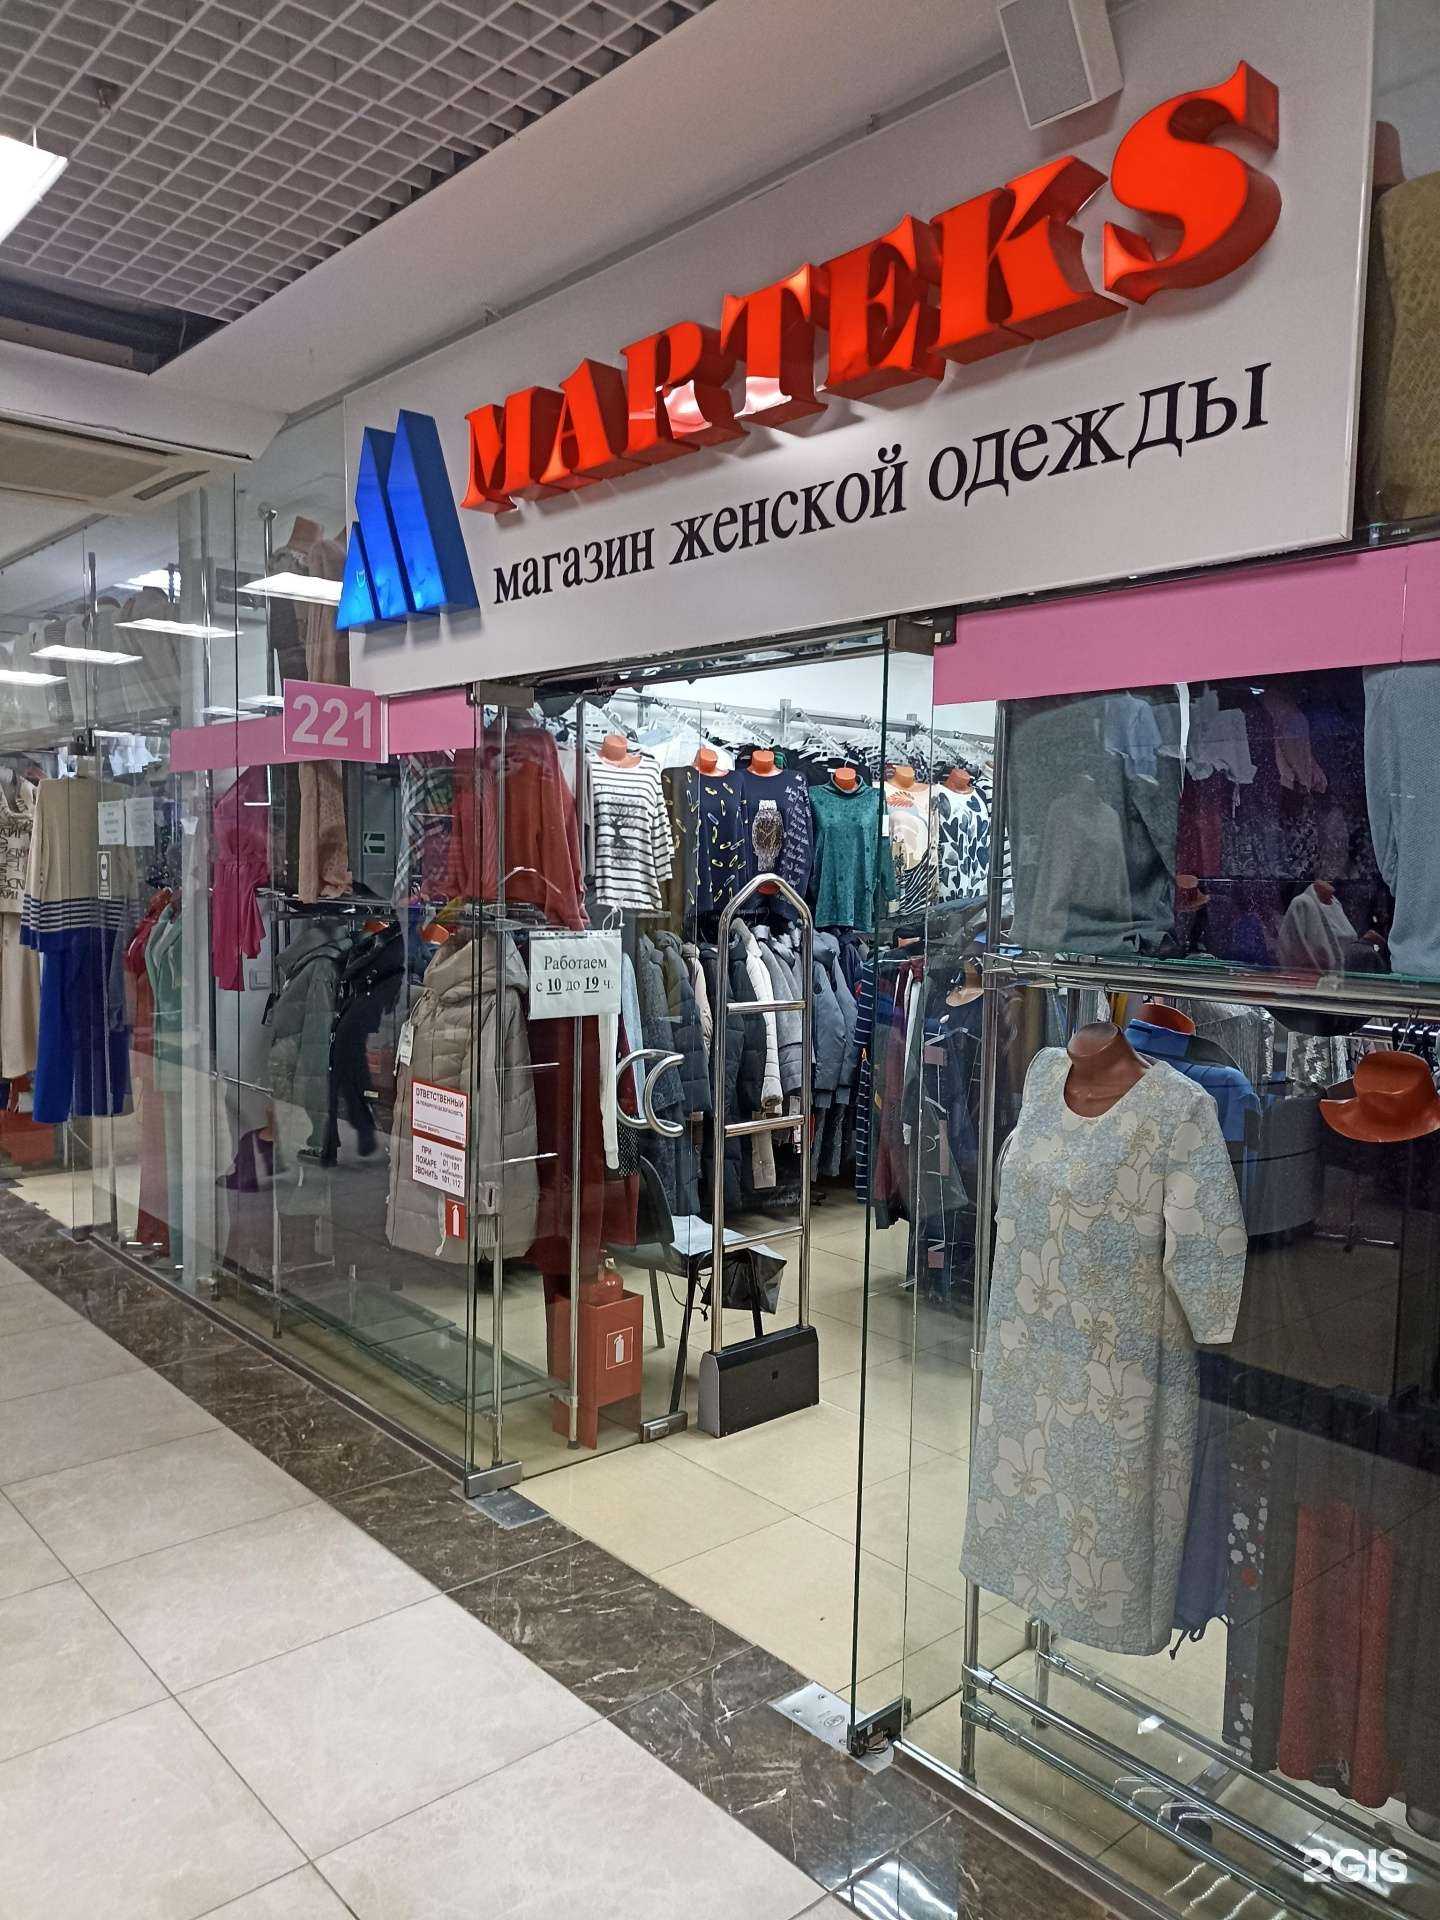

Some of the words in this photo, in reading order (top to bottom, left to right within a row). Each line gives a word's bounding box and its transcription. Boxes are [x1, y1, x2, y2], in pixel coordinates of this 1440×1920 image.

[460, 60, 1281, 512] MARTEKS
[493, 528, 655, 604] магазин
[669, 444, 907, 565] женской
[928, 362, 1272, 507] одежды
[292, 694, 372, 749] 221
[544, 953, 607, 970] Работаем
[536, 981, 543, 992] с
[547, 977, 561, 995] 10
[566, 980, 580, 991] до
[584, 976, 599, 993] 19
[415, 1087, 464, 1109] ОТВЕТСТВЕННЫЙ
[421, 1145, 432, 1154] ПРИ
[415, 1154, 437, 1169] ПОЖАРЕ
[415, 1165, 438, 1180] ЗВОНИТЬ
